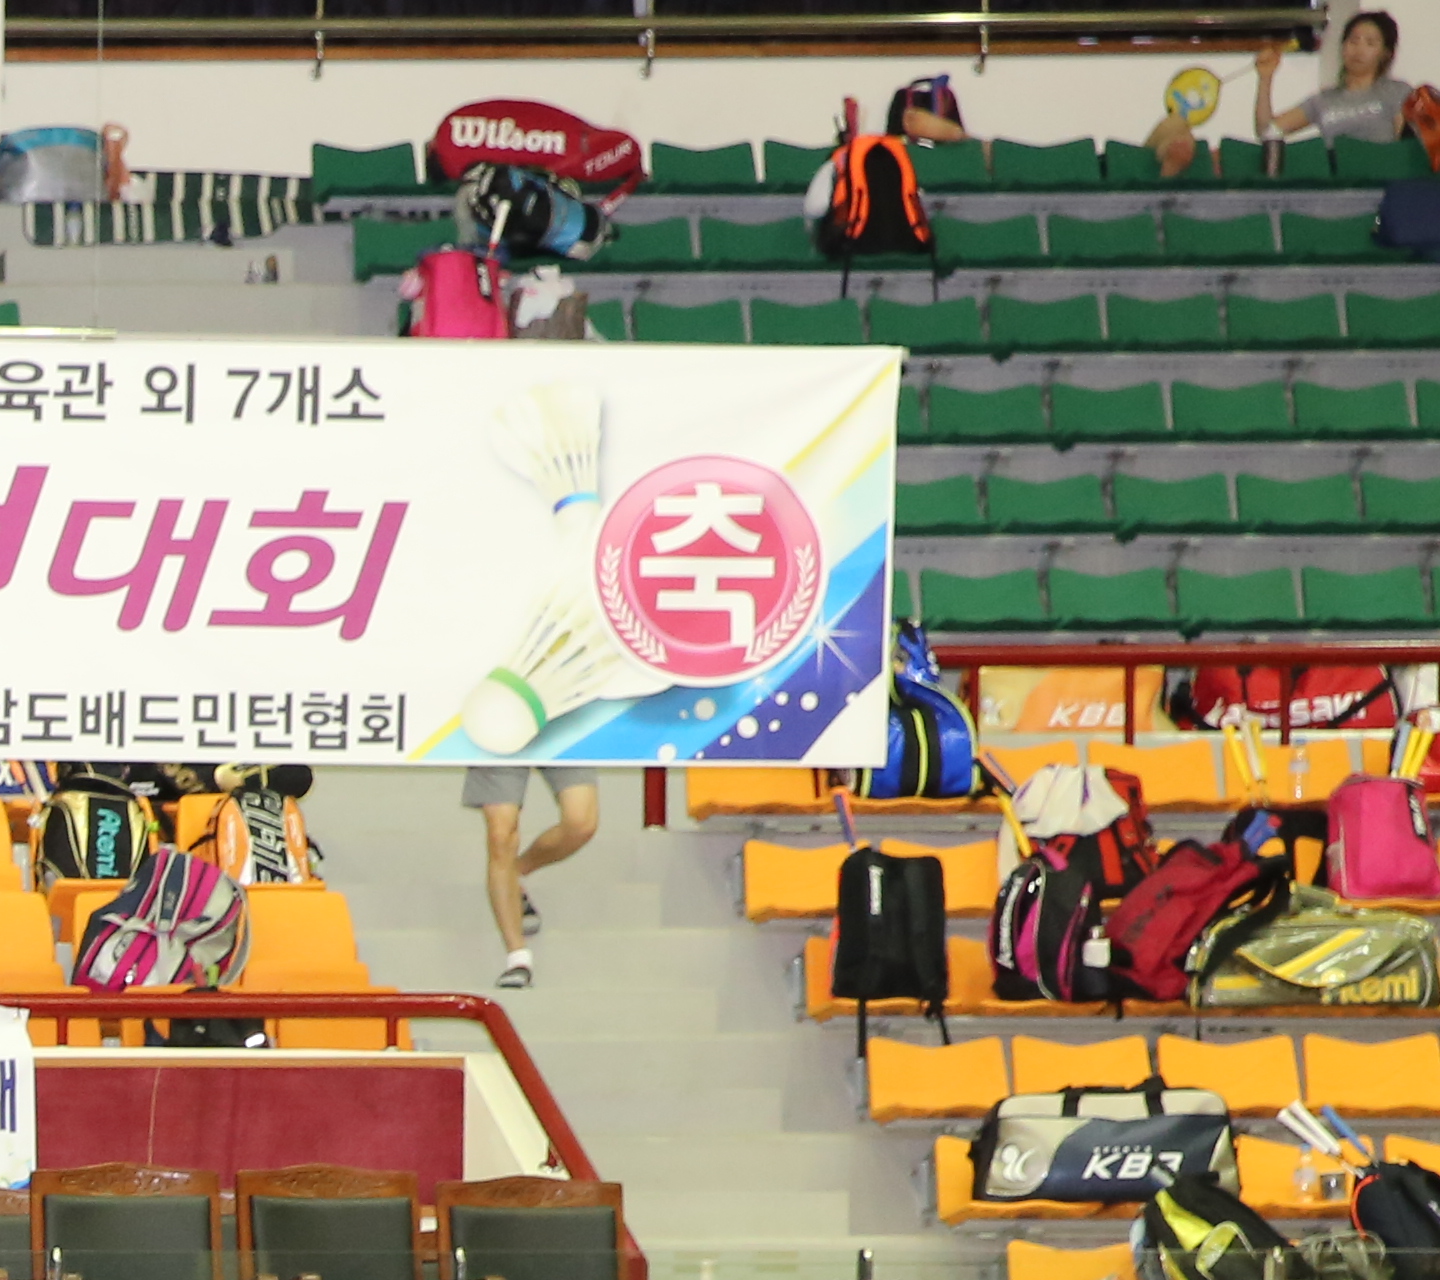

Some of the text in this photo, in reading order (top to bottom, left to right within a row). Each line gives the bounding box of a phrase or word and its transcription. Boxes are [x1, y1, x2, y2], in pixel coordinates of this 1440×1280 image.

[449, 116, 566, 156] Wilson
[141, 364, 195, 423] 외
[227, 366, 384, 425] 7개소
[639, 482, 774, 648] 축
